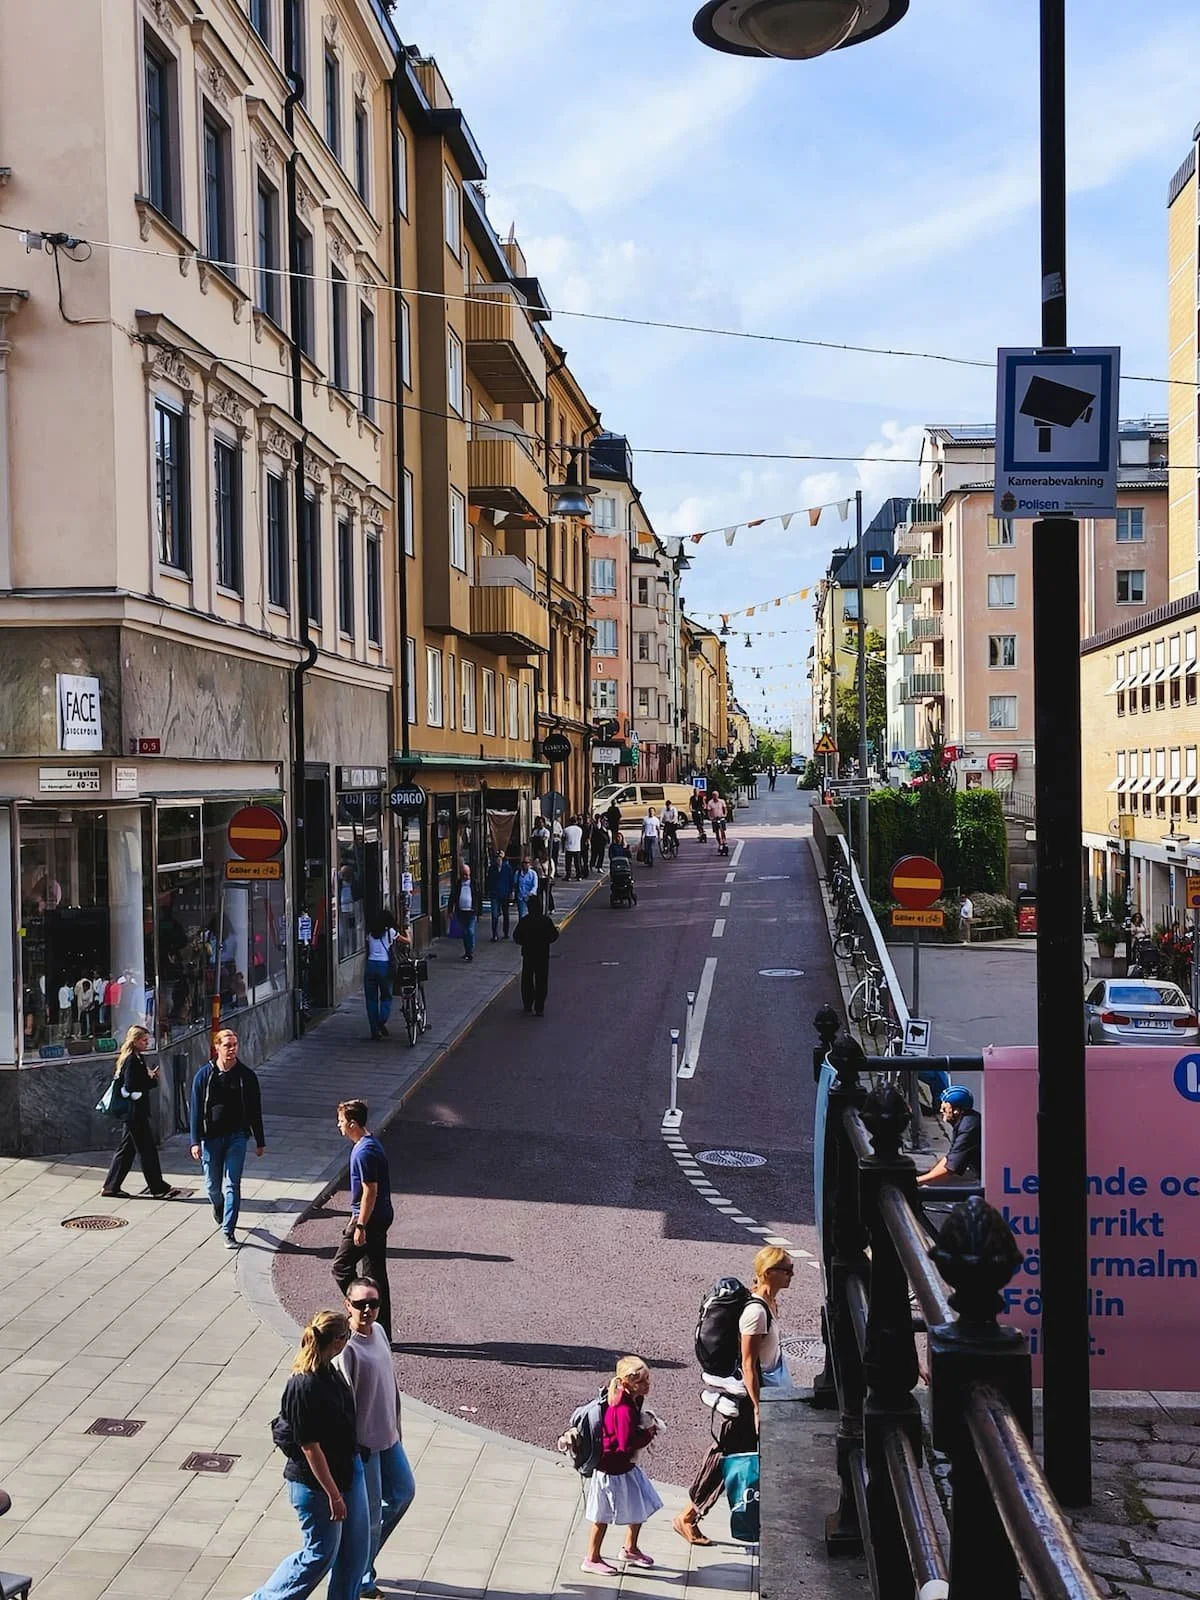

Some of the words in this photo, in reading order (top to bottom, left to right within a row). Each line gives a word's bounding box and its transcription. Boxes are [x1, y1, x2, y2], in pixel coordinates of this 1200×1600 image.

[1008, 476, 1104, 488] Kamerabevakning
[1018, 499, 1059, 509] Polisen
[66, 691, 97, 722] FACE
[390, 792, 422, 805] SPAGO
[1003, 1166, 1147, 1196] Lende
[1002, 1206, 1164, 1237] kurrikt
